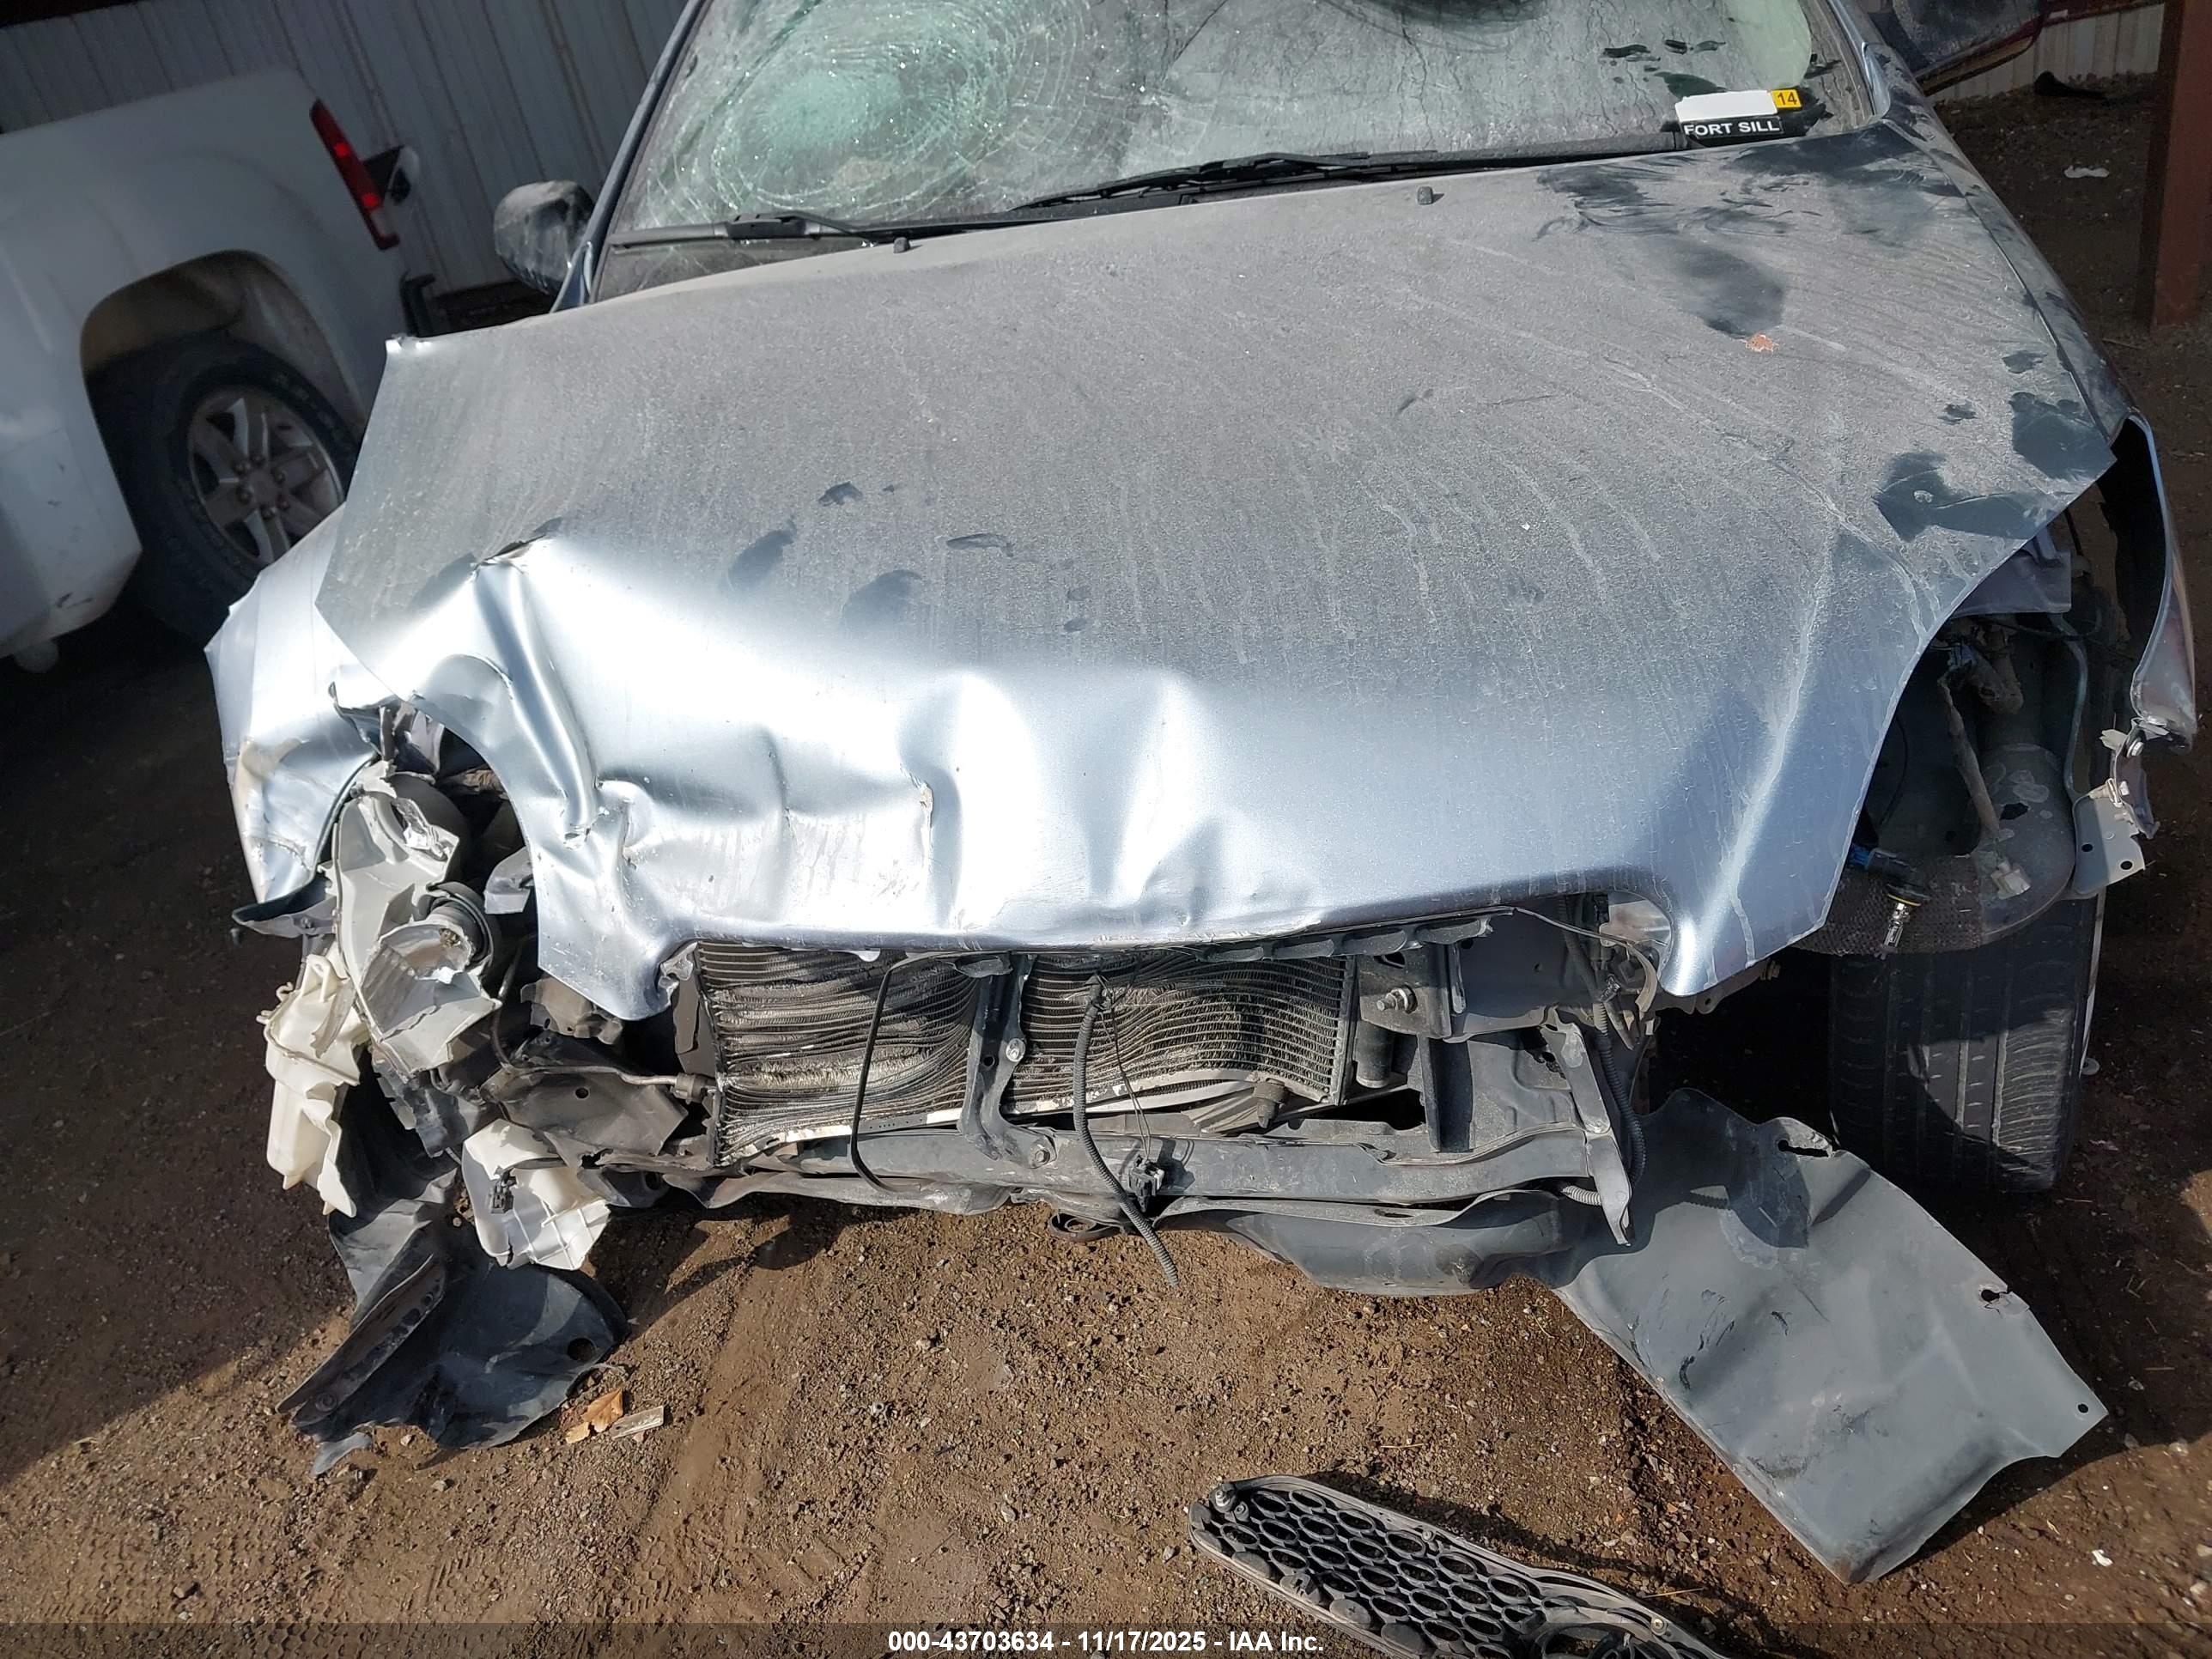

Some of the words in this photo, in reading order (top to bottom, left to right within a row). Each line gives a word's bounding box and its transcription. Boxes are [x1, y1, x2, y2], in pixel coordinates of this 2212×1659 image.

[1778, 92, 1797, 105] 14
[1684, 123, 1733, 135] FORT
[1738, 120, 1780, 132] SILL
